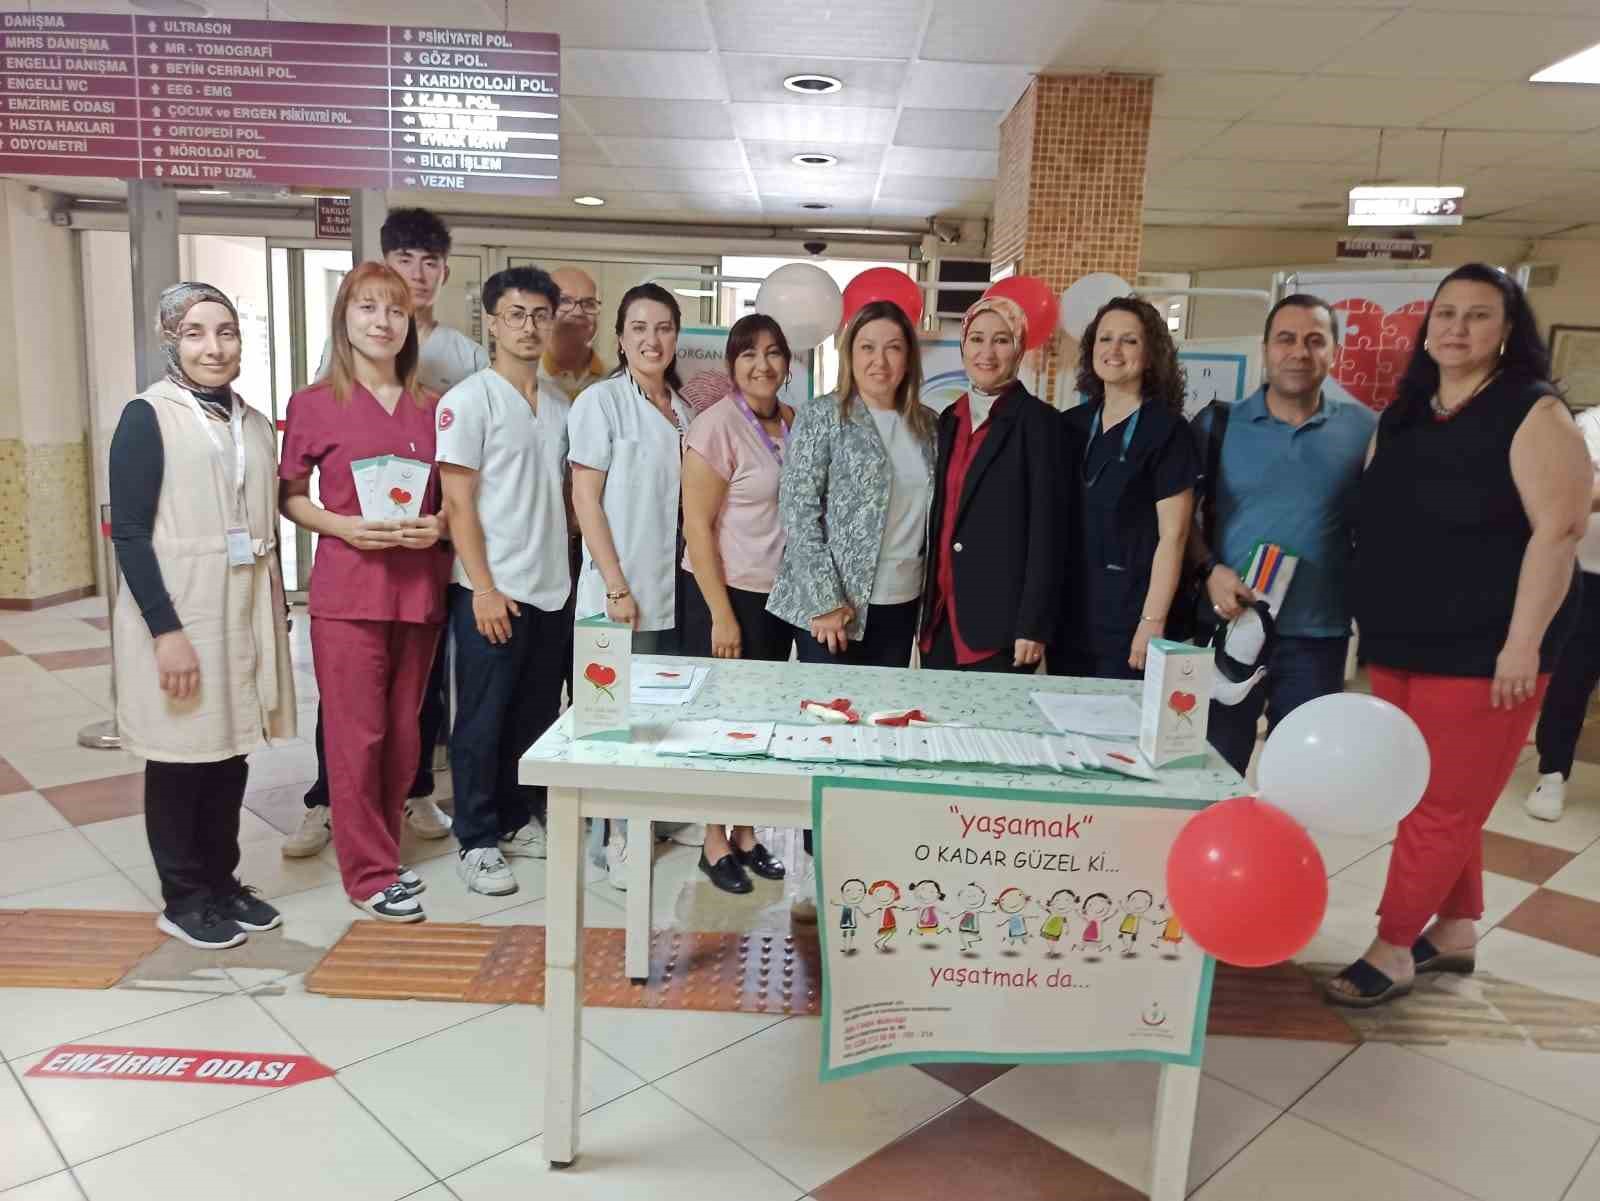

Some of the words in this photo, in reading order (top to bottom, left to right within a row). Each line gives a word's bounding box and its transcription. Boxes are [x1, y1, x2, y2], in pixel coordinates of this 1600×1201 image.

[4, 15, 65, 30] DANIŞMA
[164, 21, 232, 35] ULTRASON
[5, 37, 44, 50] MHRS
[47, 38, 110, 54] DANIŞMA
[418, 29, 483, 46] PSİKİYATRİ
[486, 36, 513, 48] POL.
[164, 43, 186, 54] MR
[196, 44, 273, 58] TOMOGRAFİ
[419, 50, 451, 66] GÖZ
[454, 54, 488, 67] POL.
[6, 56, 62, 71] ENGELLİ
[65, 59, 128, 75] DANIŞMA
[166, 62, 205, 75] BEYİN
[207, 63, 265, 78] CERRAHİ
[267, 67, 297, 79] POL.
[7, 77, 64, 91] ENGELLİ
[67, 80, 89, 92] WC
[167, 83, 194, 95] EEG
[203, 86, 233, 97] EMG
[419, 73, 517, 91] KARDİYOLOJİ
[520, 80, 555, 93] POL.
[8, 97, 71, 112] EMZİRME
[73, 100, 116, 114] ODASI
[168, 105, 214, 120] ÇOCUK
[216, 109, 231, 118] ve
[233, 107, 278, 119] ERGEN
[280, 107, 331, 123] PSİKİYATRİ
[9, 119, 54, 132] HASTA
[56, 121, 116, 134] HAKLARI
[169, 125, 234, 139] ORTOPEDİ
[236, 128, 265, 140] POL.
[10, 138, 89, 152] ODYOMETRİ
[169, 144, 235, 158] NÖROLOJİ
[237, 148, 267, 160] POL.
[420, 152, 457, 168] BİLGİ
[460, 153, 502, 172] İŞLEM
[170, 163, 200, 177] ADLİ
[202, 166, 222, 178] TIP
[225, 167, 257, 179] UZM.
[420, 175, 465, 189] VEZNE
[676, 349, 723, 360] ORGAN
[914, 845, 931, 862] O
[937, 846, 1007, 868] KADAR
[1013, 849, 1081, 873] GÜZEL
[1088, 851, 1121, 874] Kİ...
[929, 966, 1038, 989] yaşatmak
[1046, 967, 1090, 989] da...
[41, 1051, 198, 1077] EMZİRME
[194, 1059, 297, 1082] ODASI
